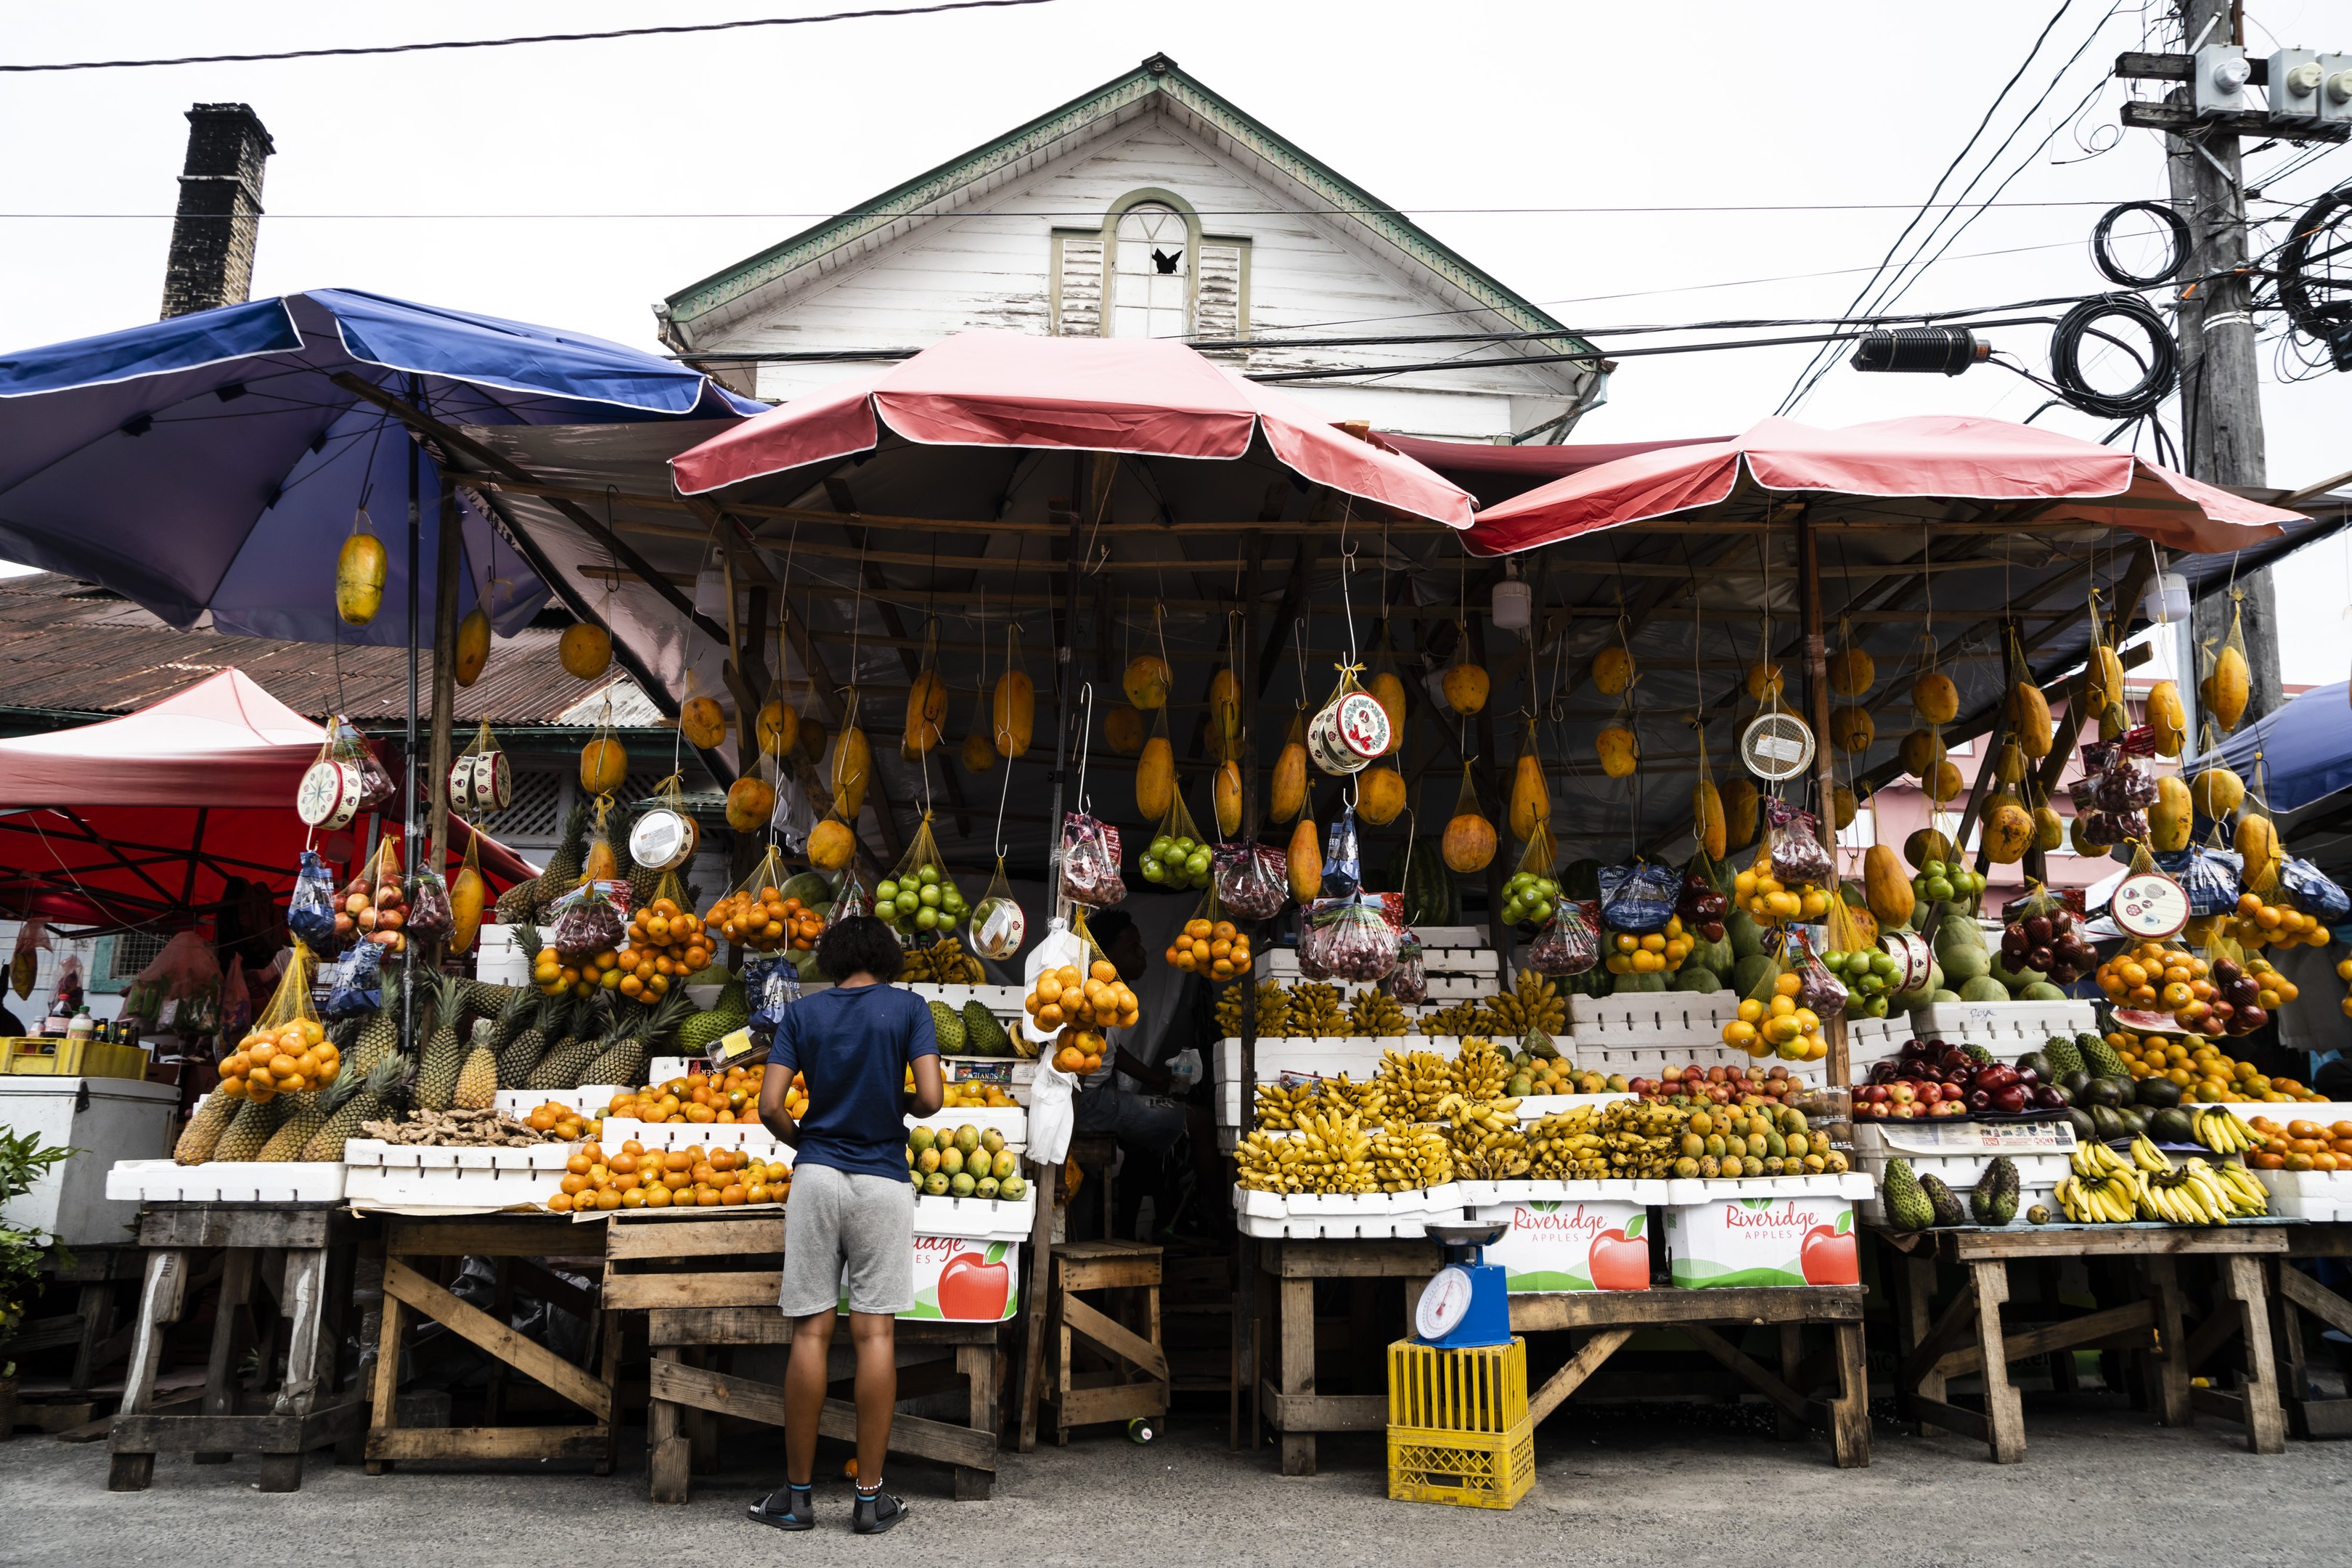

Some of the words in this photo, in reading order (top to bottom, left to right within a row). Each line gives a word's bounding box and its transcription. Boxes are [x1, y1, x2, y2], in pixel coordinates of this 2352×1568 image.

[1514, 1204, 1606, 1239] Riveridge
[1727, 1201, 1818, 1236] Riveridge
[1532, 1233, 1579, 1242] APPLES
[1745, 1230, 1792, 1239] APPLES
